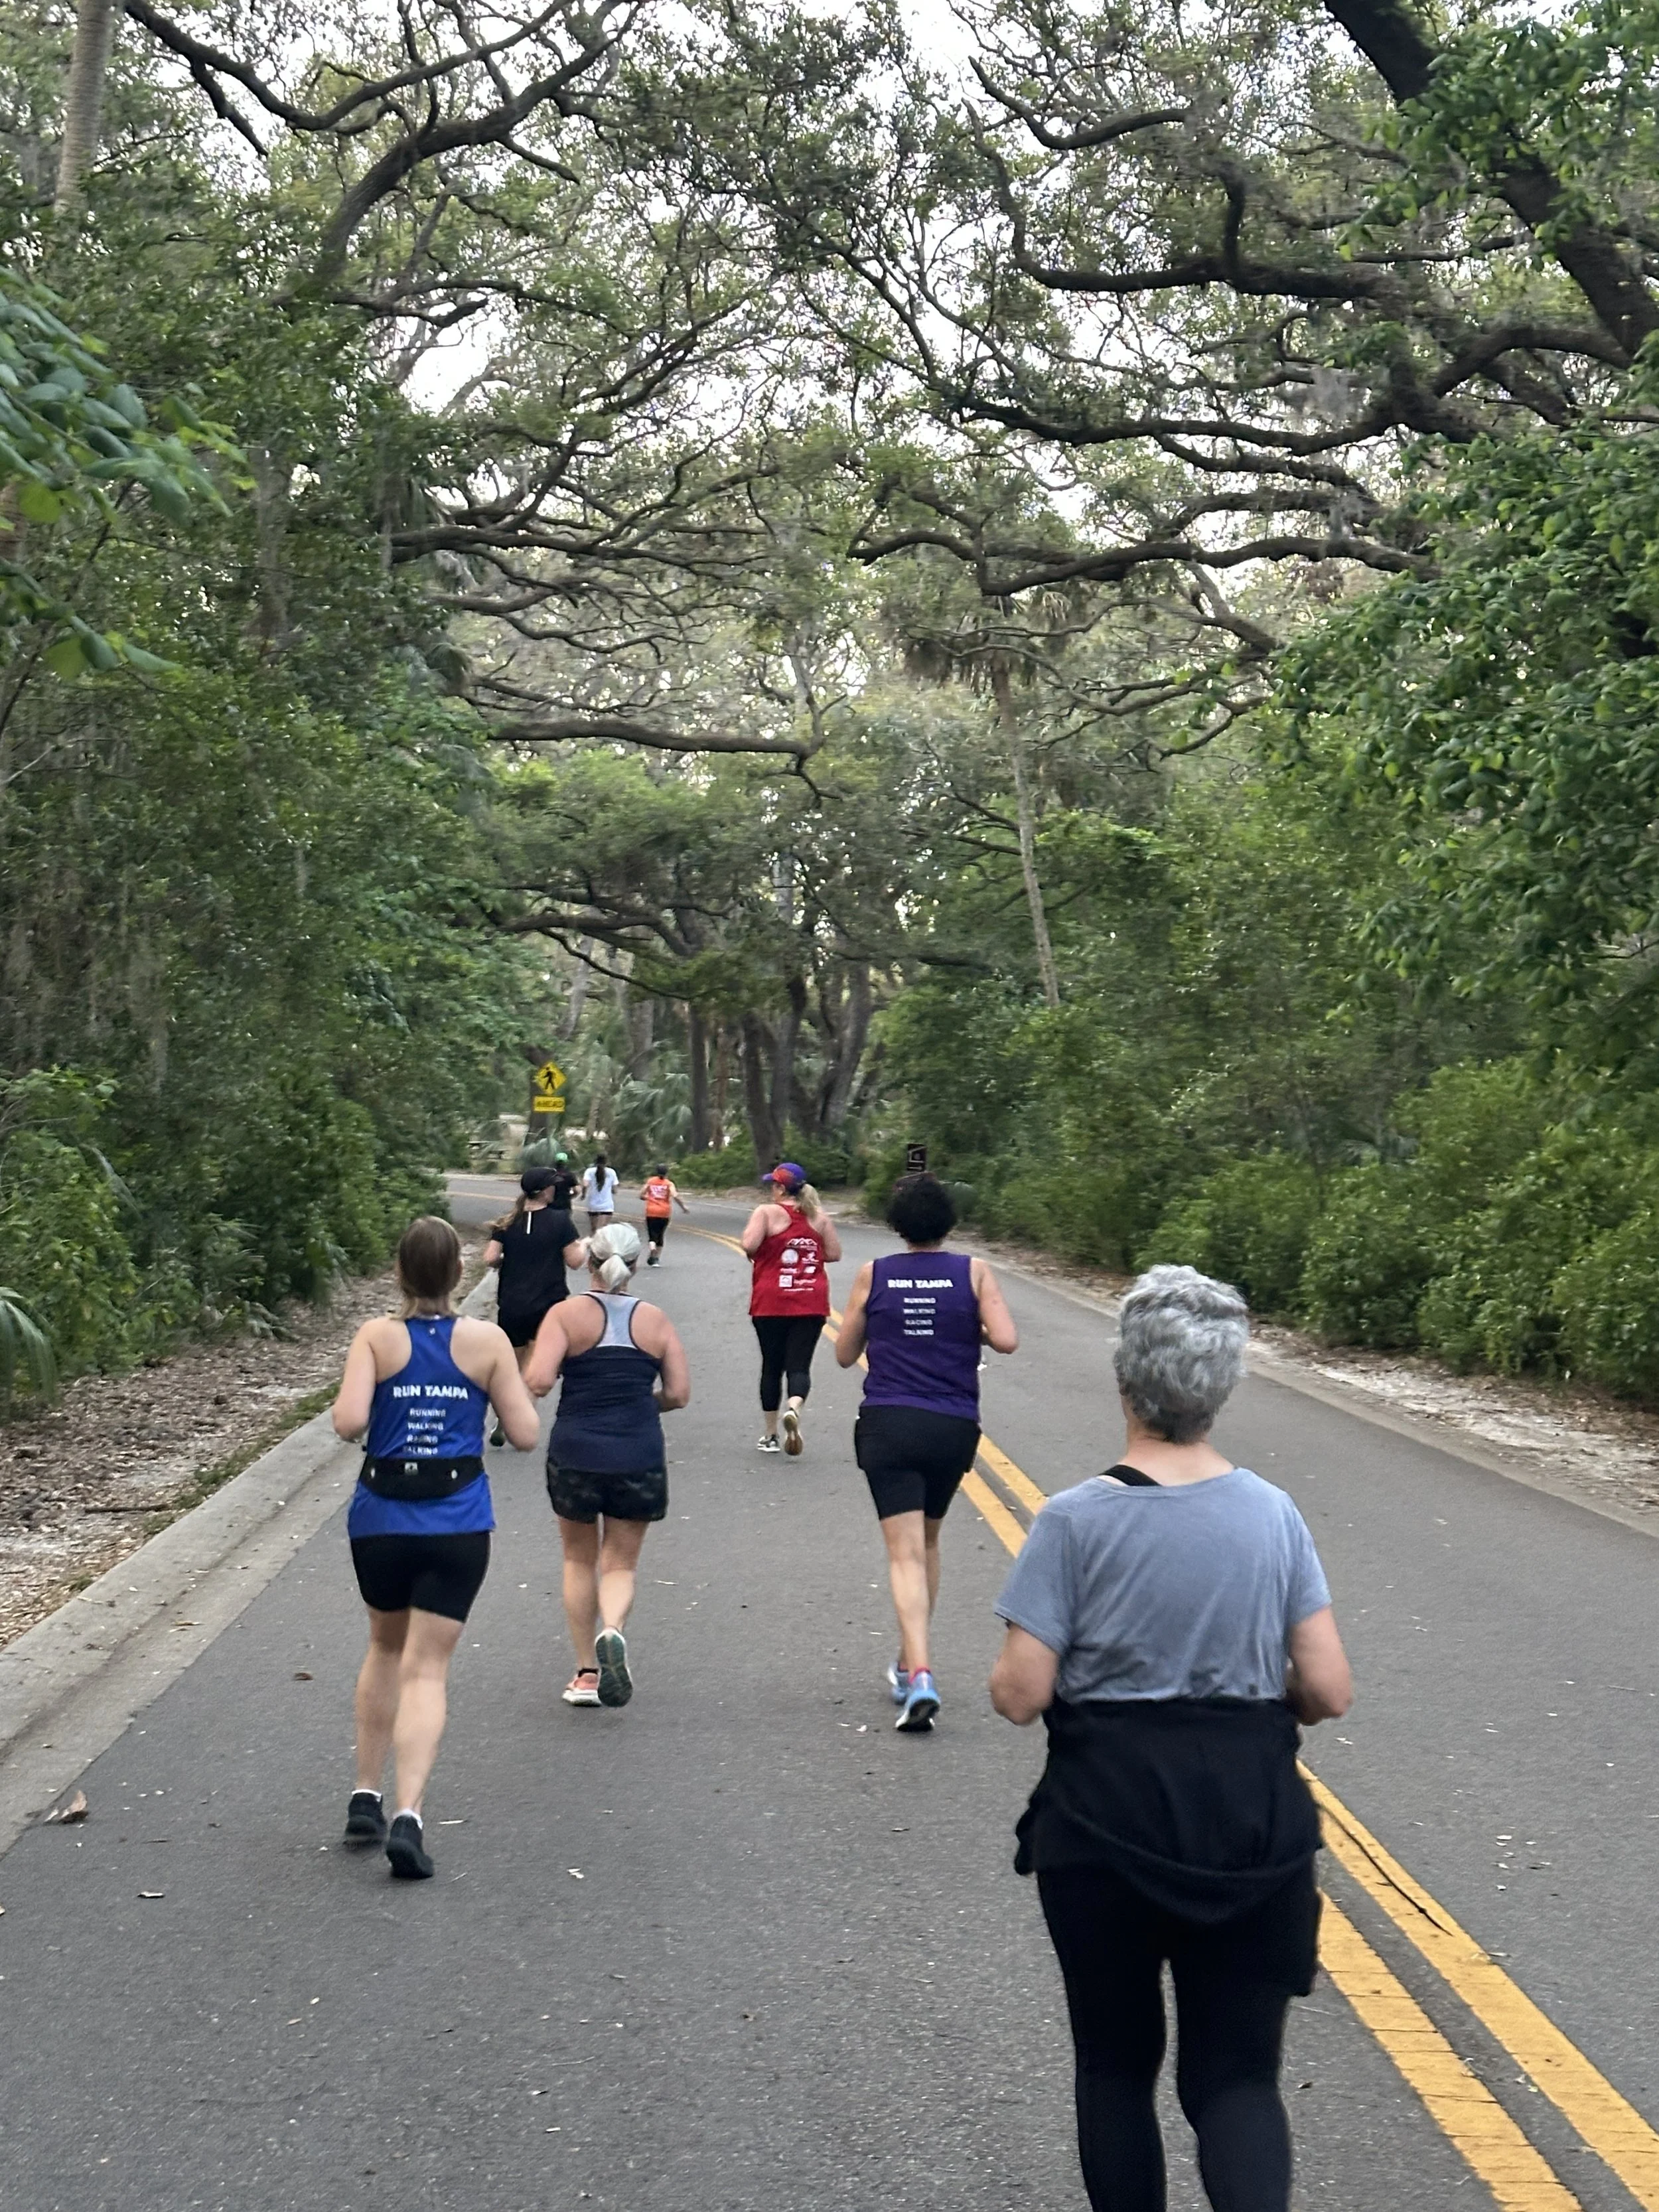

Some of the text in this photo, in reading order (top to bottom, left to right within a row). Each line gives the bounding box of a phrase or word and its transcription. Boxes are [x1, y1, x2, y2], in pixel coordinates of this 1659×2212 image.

[888, 1279, 954, 1288] RUN TAMPA
[393, 1385, 469, 1400] RUN TAMPA
[409, 1408, 446, 1417] RUNNING
